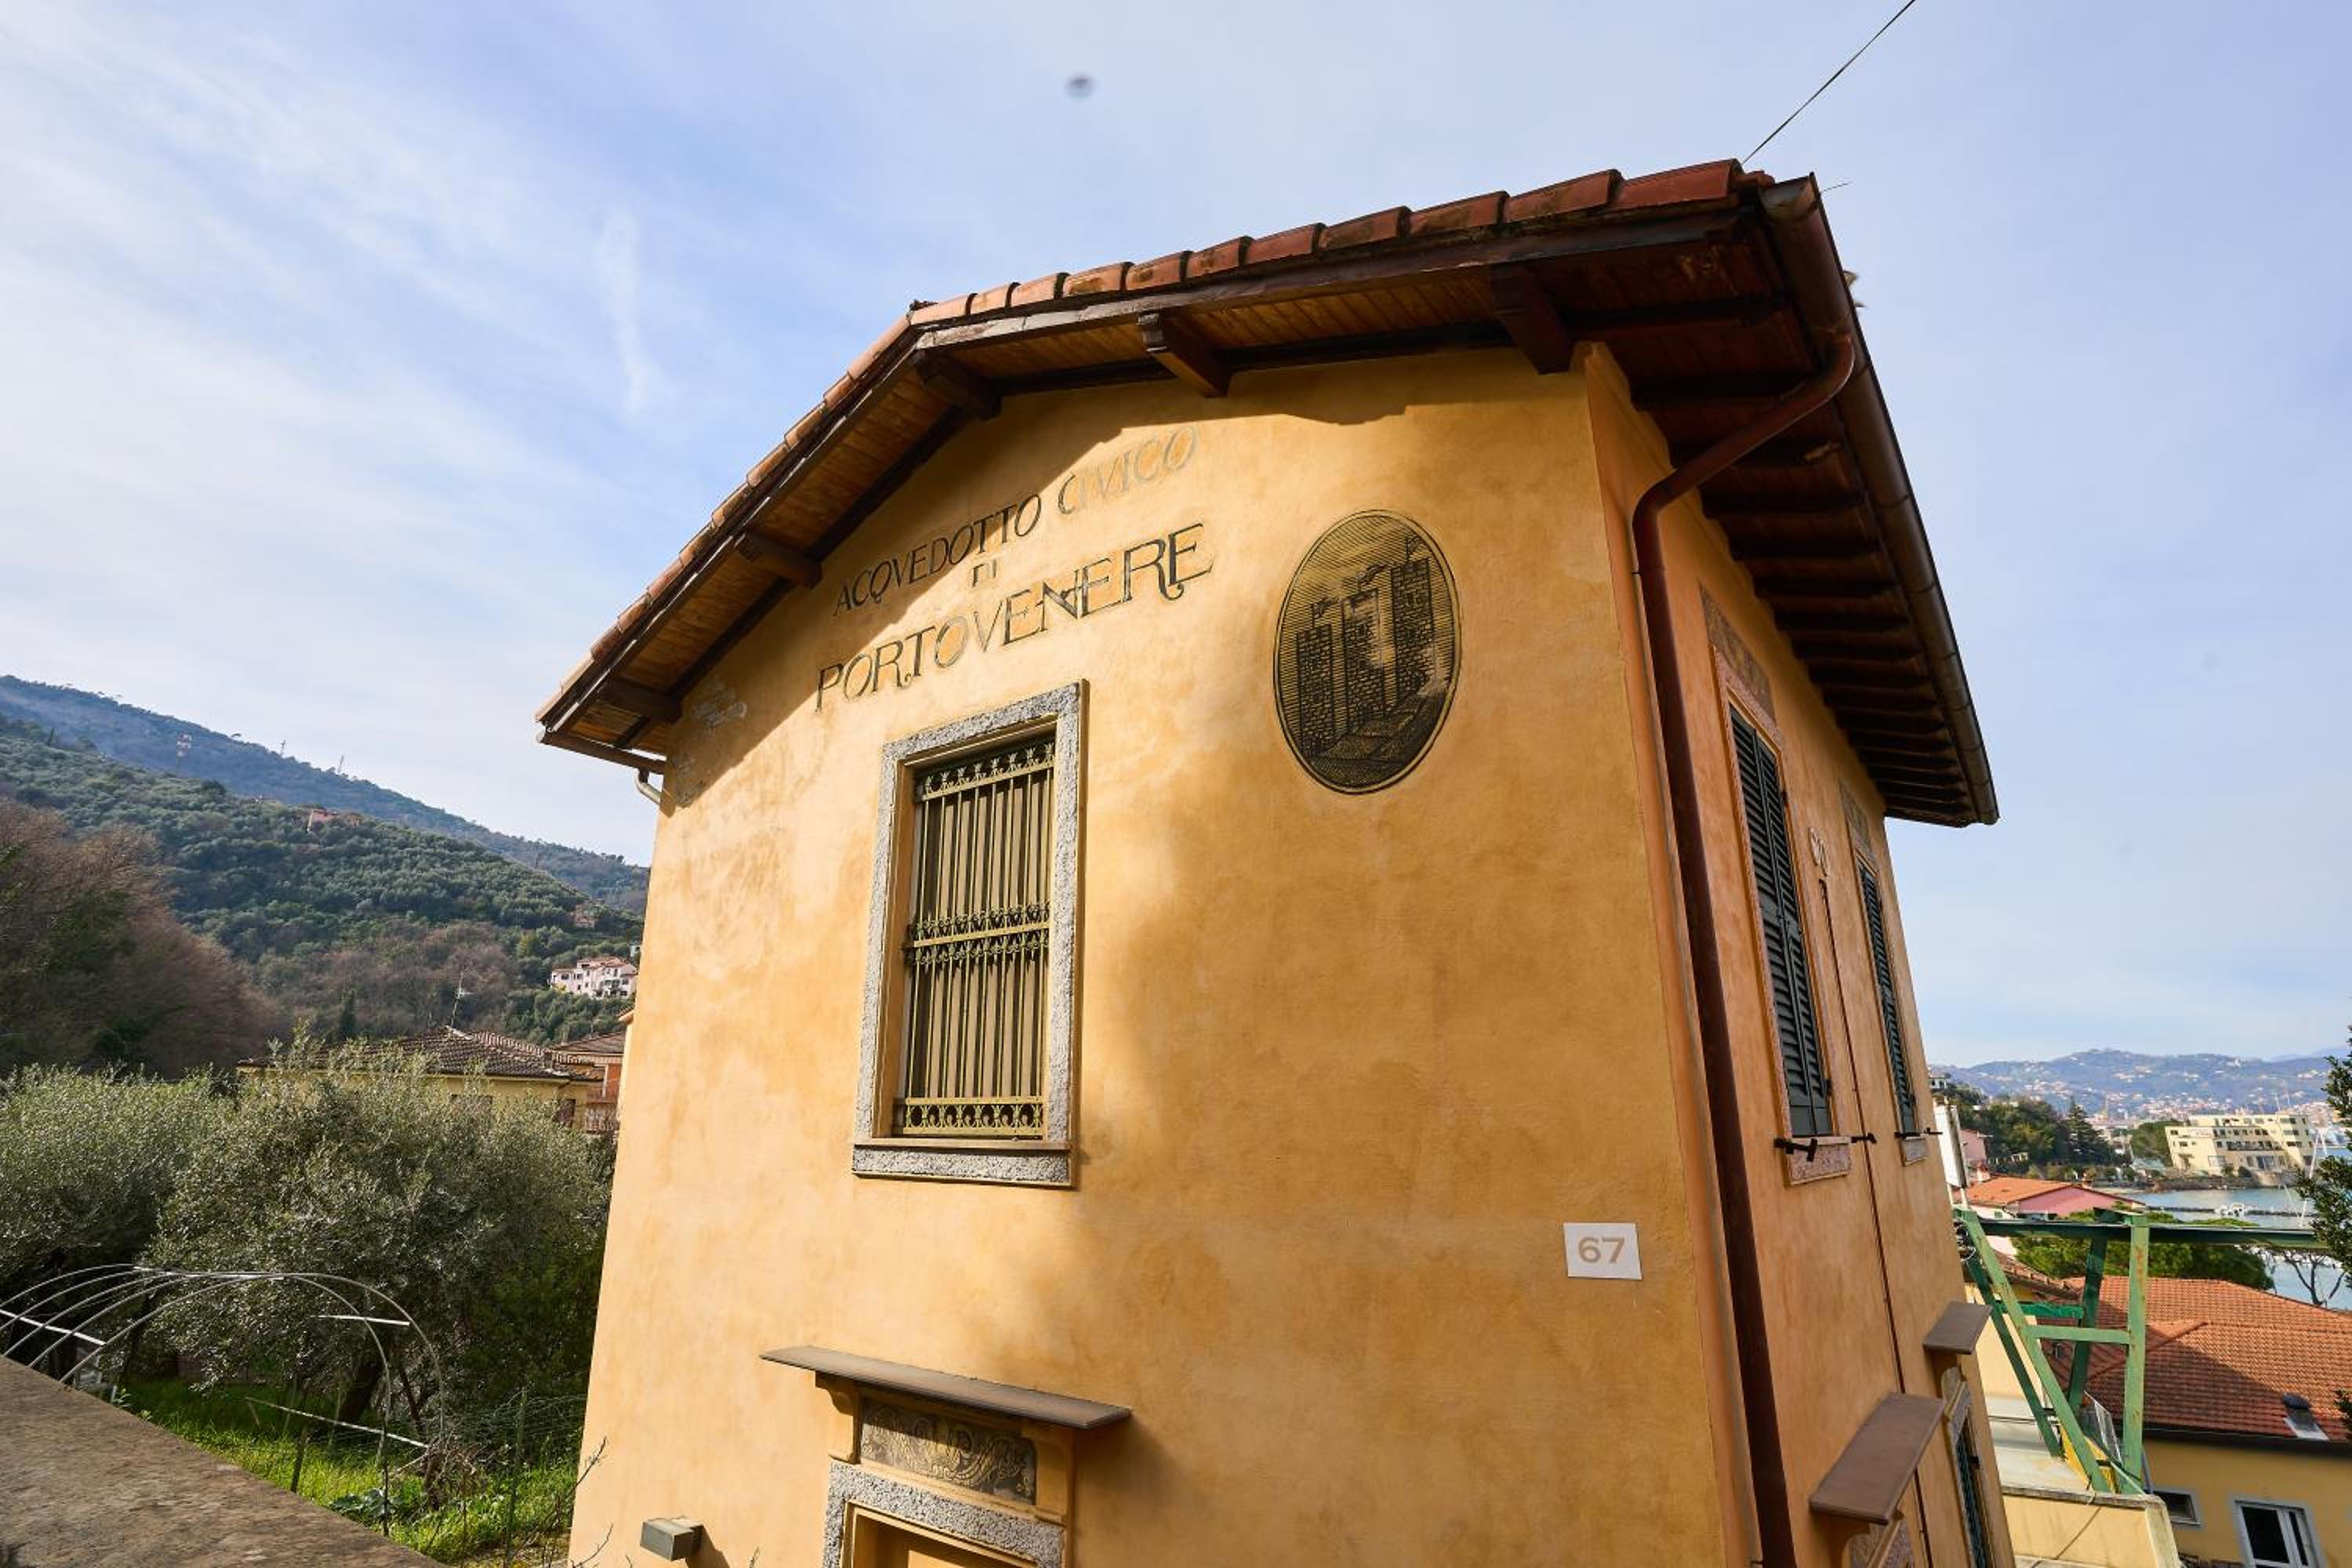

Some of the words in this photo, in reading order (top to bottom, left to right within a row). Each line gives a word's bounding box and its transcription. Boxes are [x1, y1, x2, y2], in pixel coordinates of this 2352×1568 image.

[832, 493, 1042, 616] ACQVEDOTTO
[1058, 426, 1200, 514] CIVICO
[814, 523, 1214, 713] PORTOVENERE
[1578, 1236, 1625, 1263] 67
